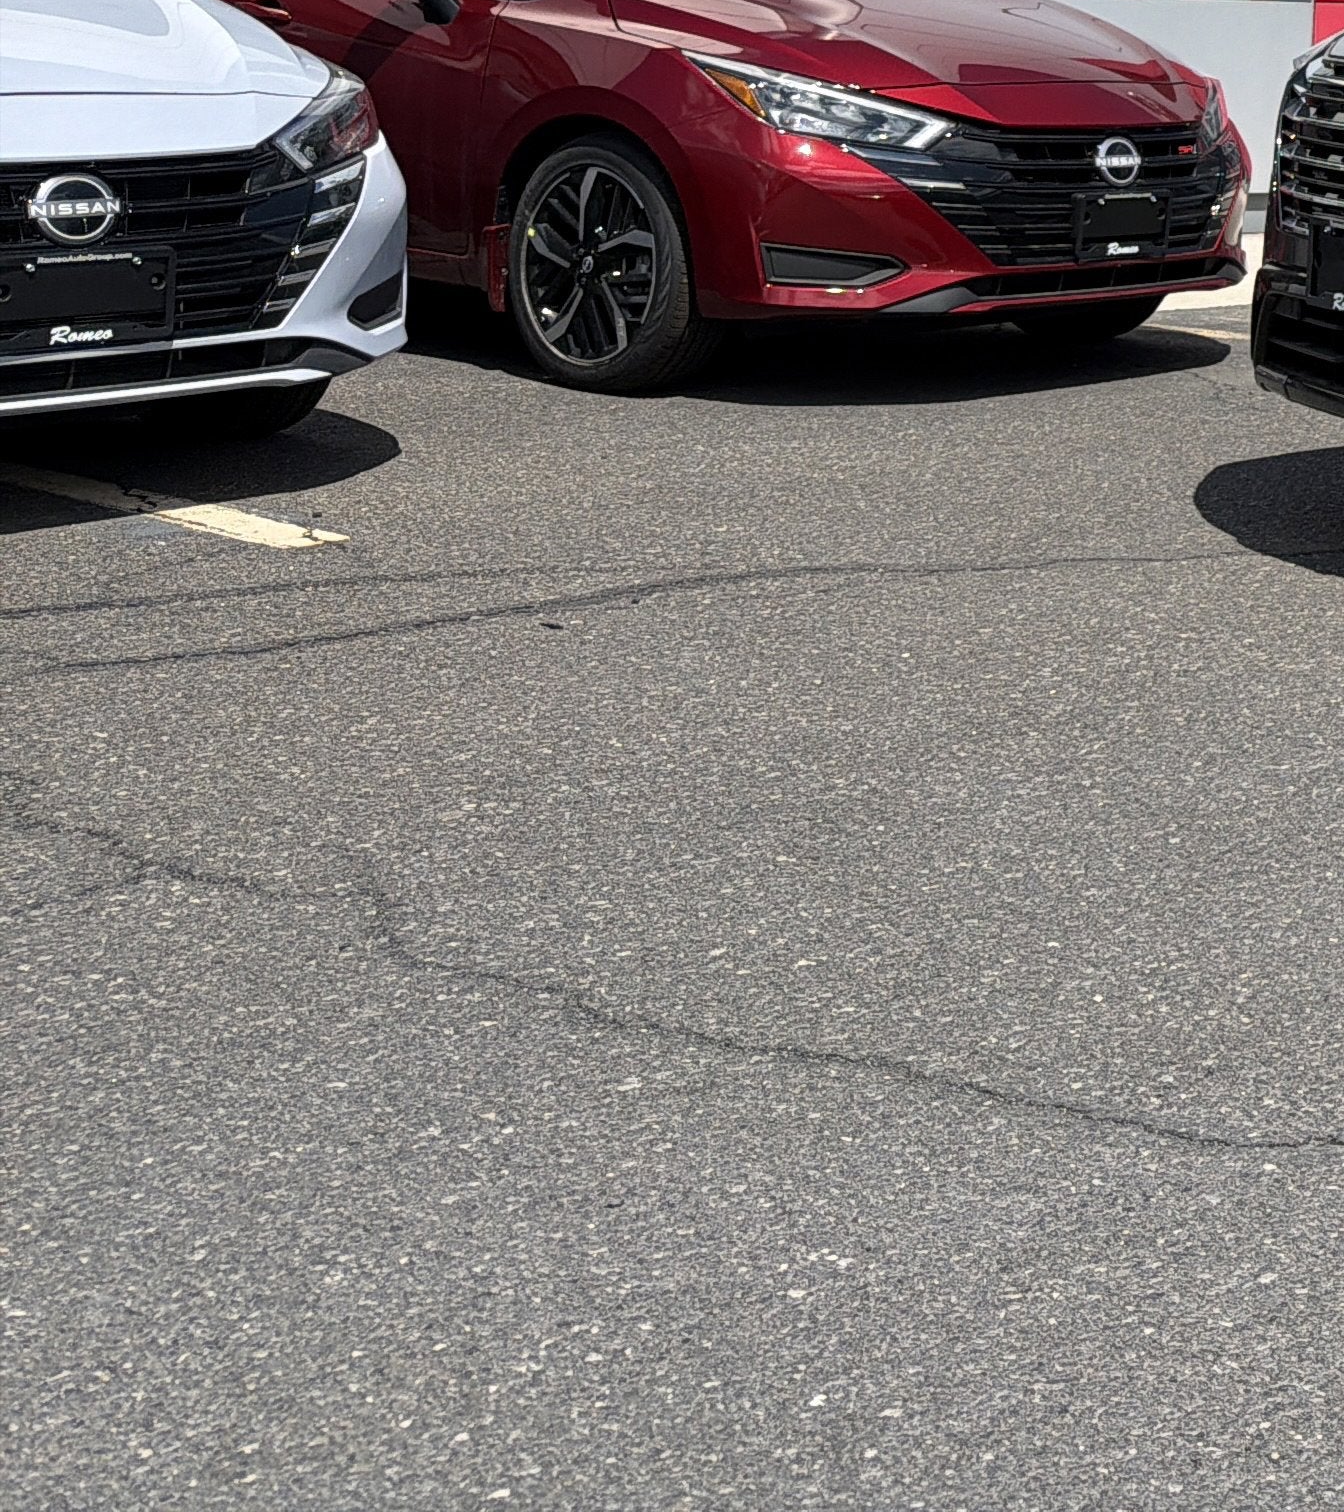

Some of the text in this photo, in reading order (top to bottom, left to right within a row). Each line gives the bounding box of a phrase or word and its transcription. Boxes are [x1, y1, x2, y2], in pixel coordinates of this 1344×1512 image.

[1096, 155, 1141, 167] NISSAN
[29, 201, 121, 217] NISSAN
[49, 325, 114, 346] Romeo
